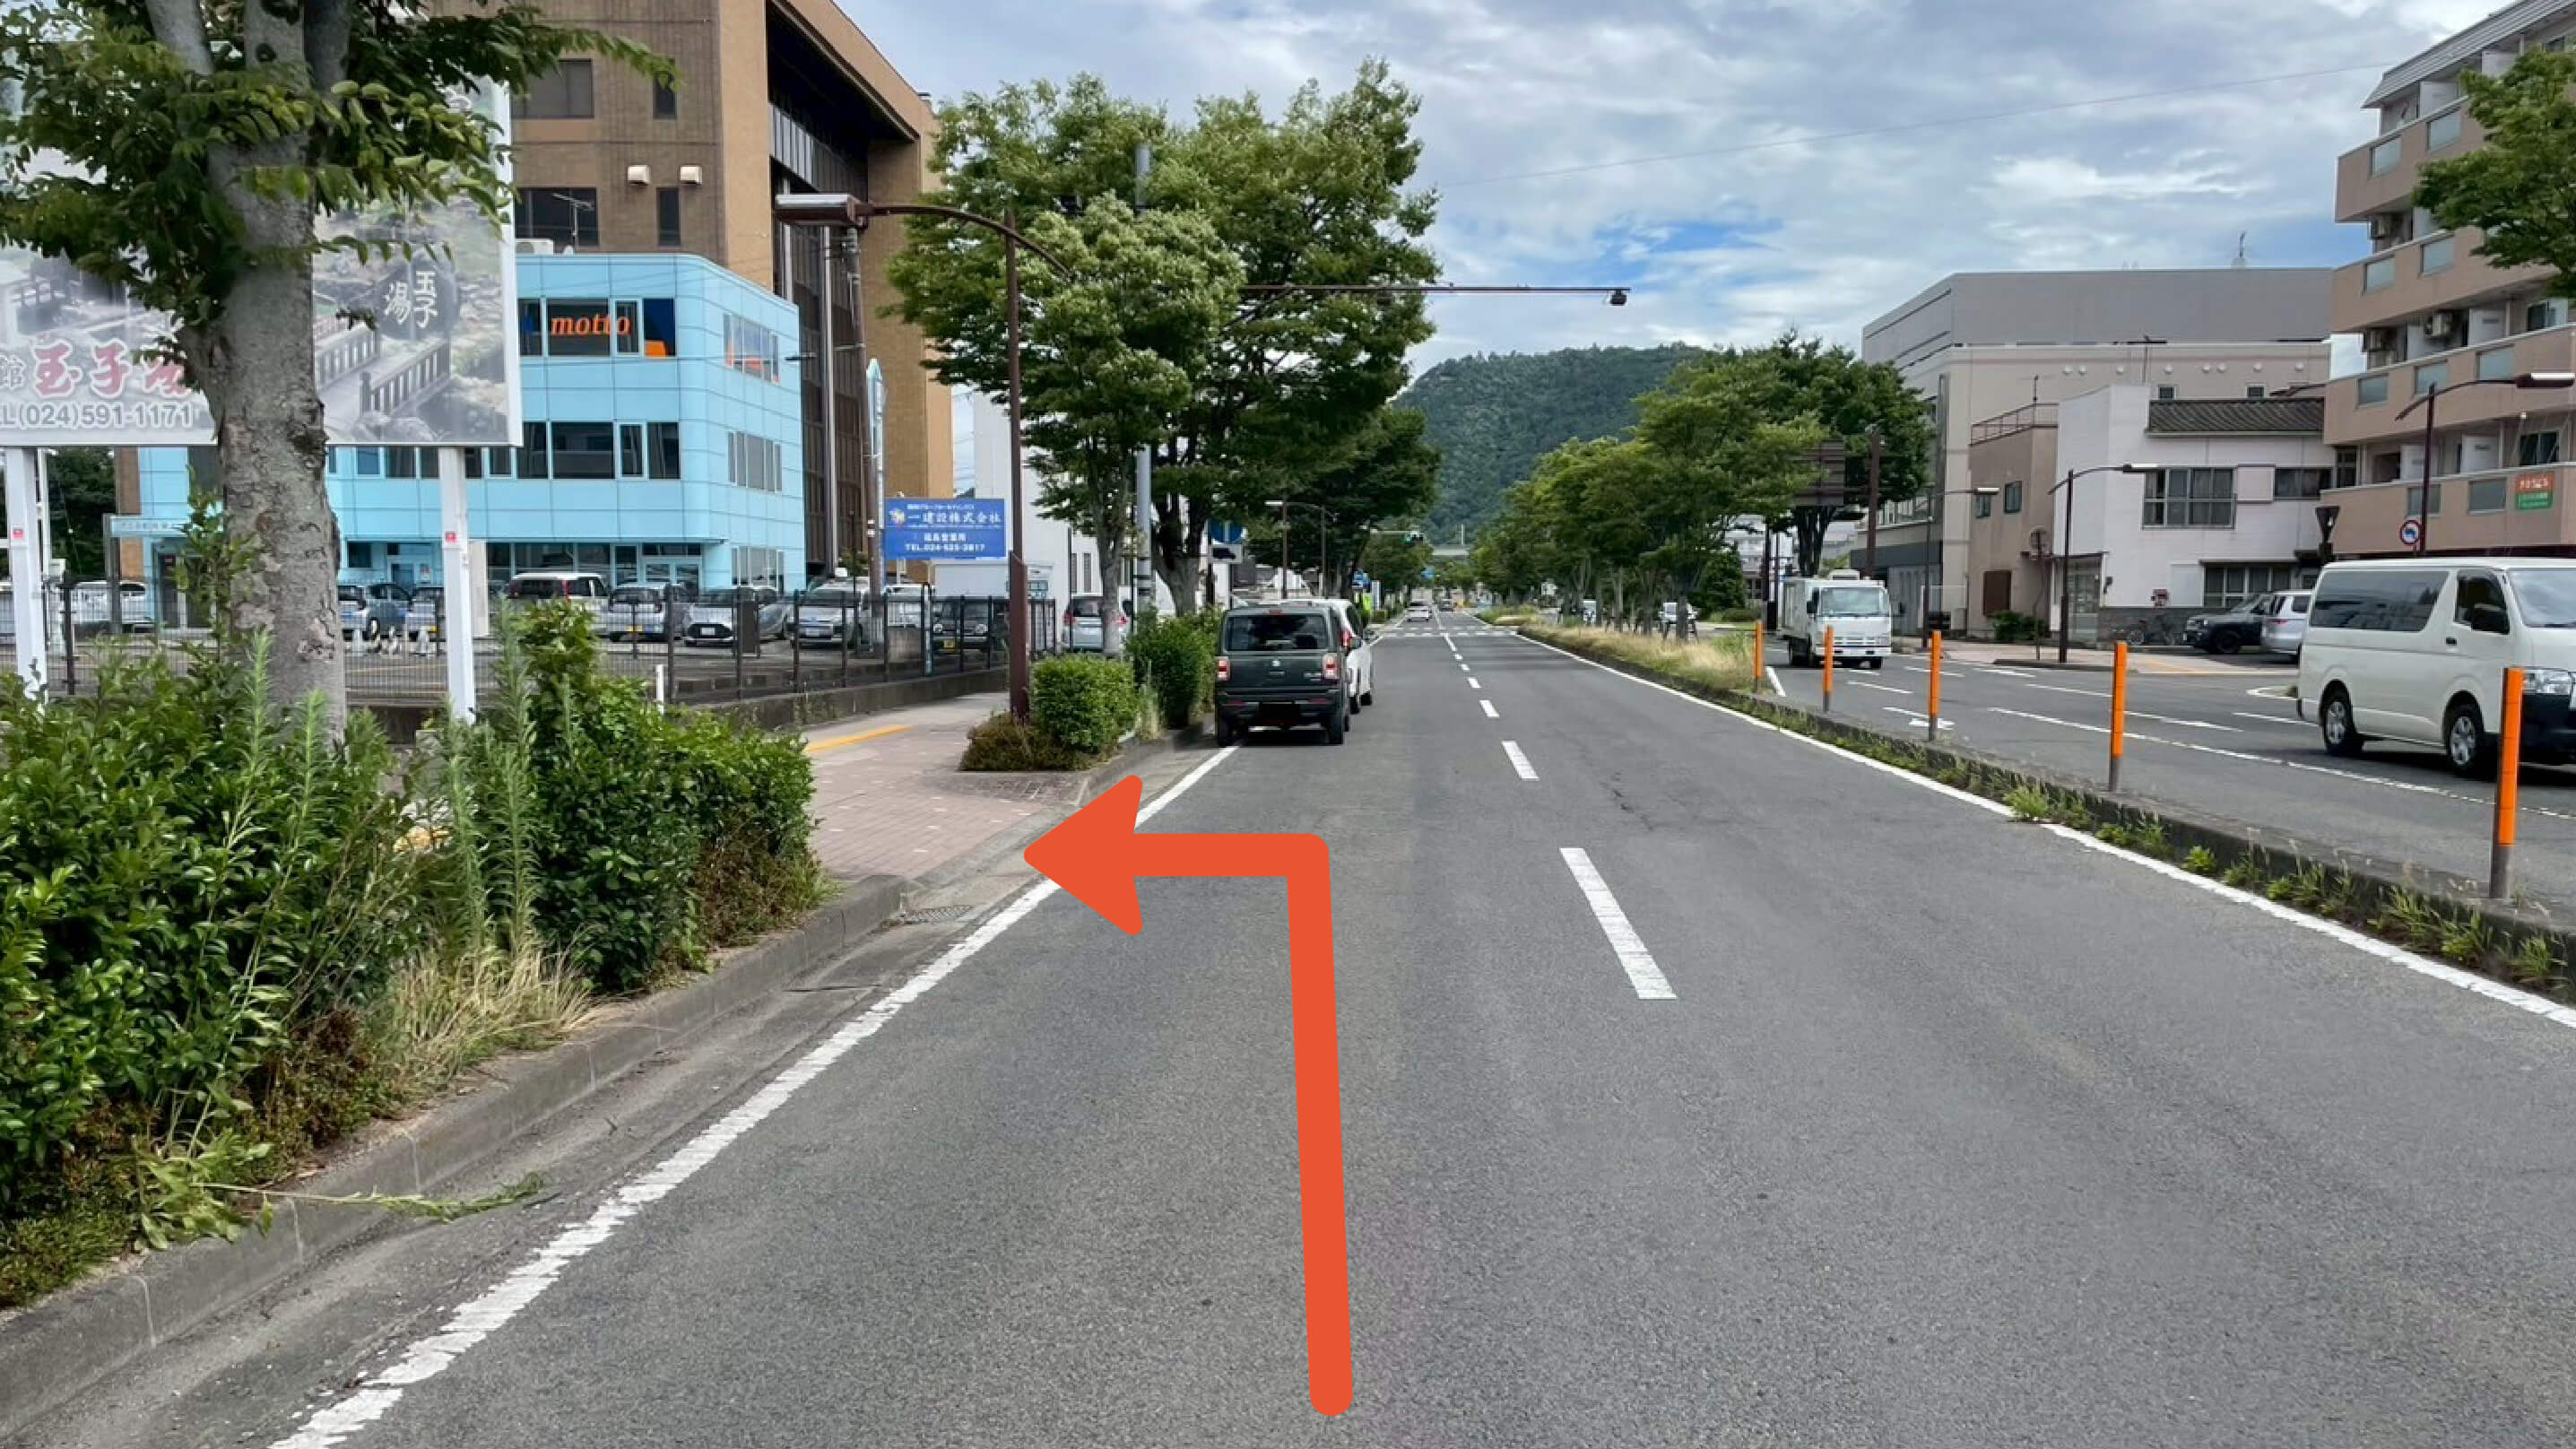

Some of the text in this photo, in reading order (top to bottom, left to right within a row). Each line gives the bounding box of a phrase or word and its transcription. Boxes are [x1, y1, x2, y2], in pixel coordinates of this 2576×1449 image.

[414, 270, 438, 328] 玉子
[551, 313, 632, 337] motto
[0, 403, 192, 429] L(024)591-1171
